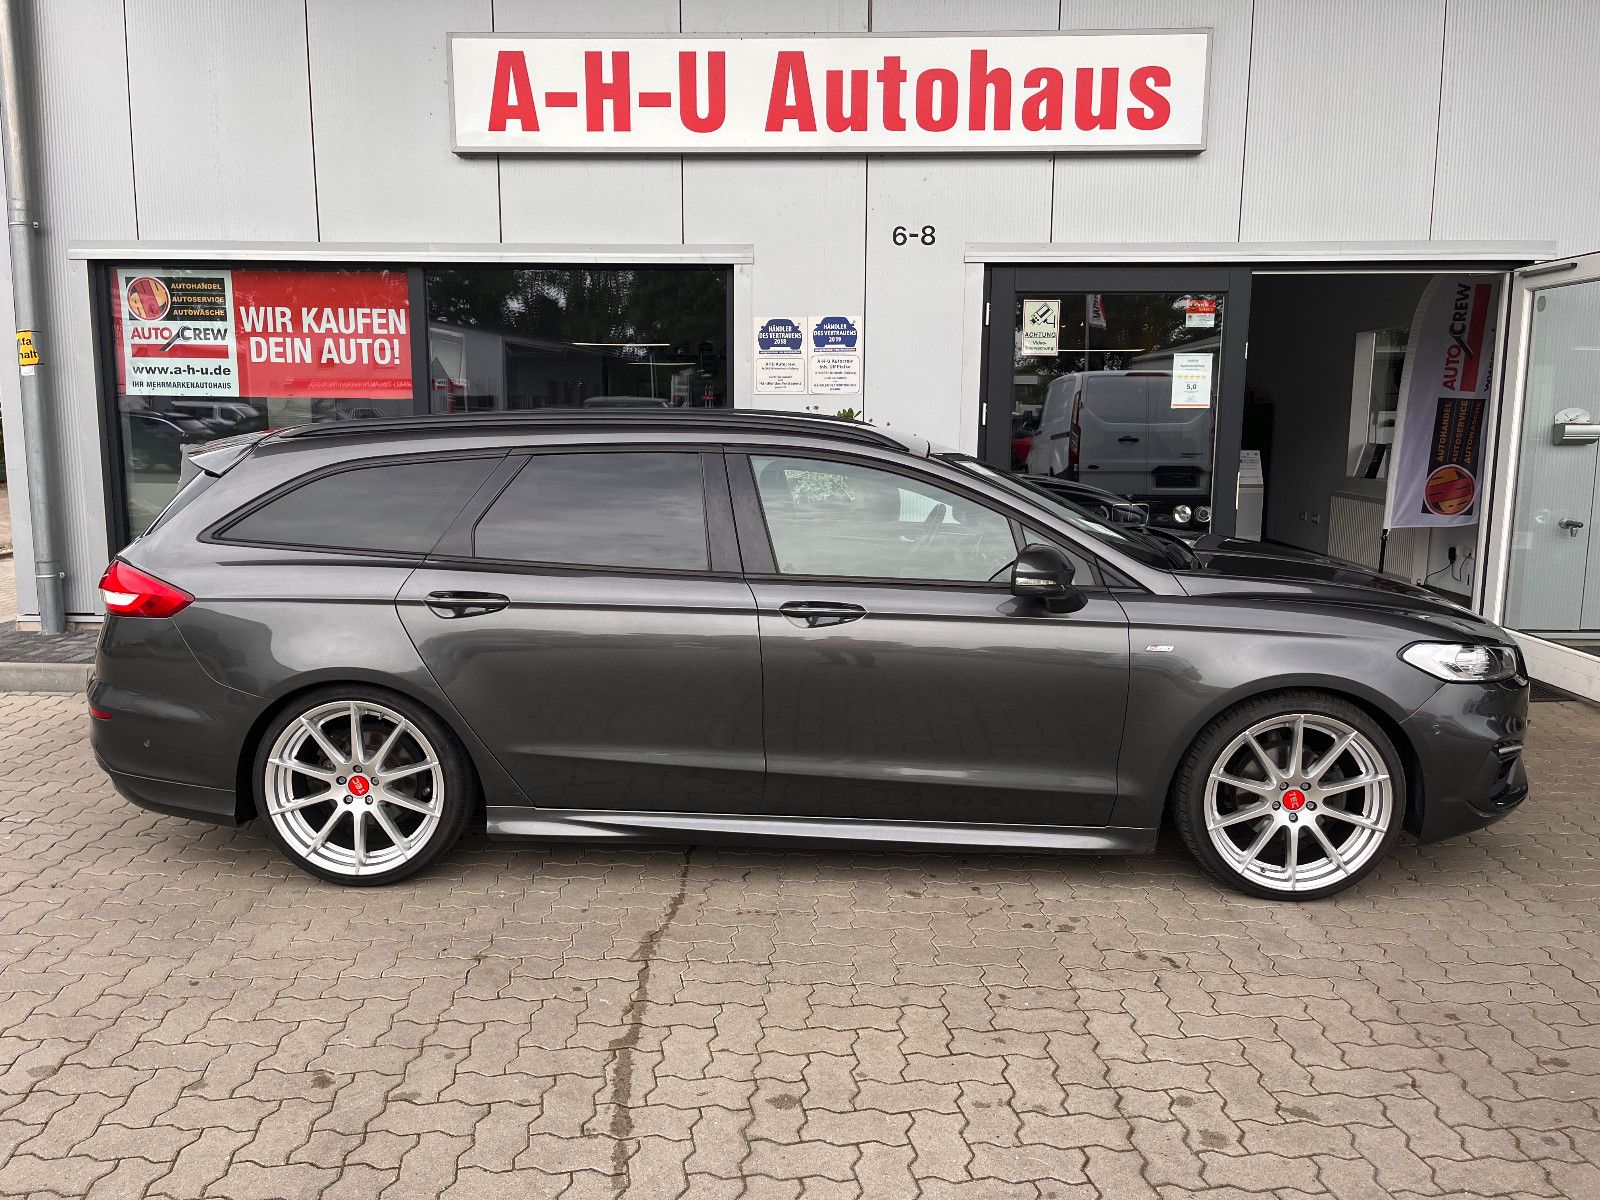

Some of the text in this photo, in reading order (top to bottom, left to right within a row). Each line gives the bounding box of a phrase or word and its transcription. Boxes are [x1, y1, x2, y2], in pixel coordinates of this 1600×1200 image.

[488, 49, 1171, 133] A-H-U Autohaus
[892, 225, 936, 246] 6-8
[170, 282, 222, 290] AUTOHANDEL
[239, 306, 407, 335] WIR KAUFEN
[768, 324, 792, 332] HÄNDLER
[823, 322, 847, 330] HÄNDLER
[250, 336, 400, 365] DEIN AUTO!
[132, 364, 232, 376] www.a-h-u.de
[146, 381, 232, 389] MEHRMARKENAUTOHAUS
[1437, 401, 1452, 462] AUTOHANDEL
[1452, 400, 1469, 463] AUTOSERVICE
